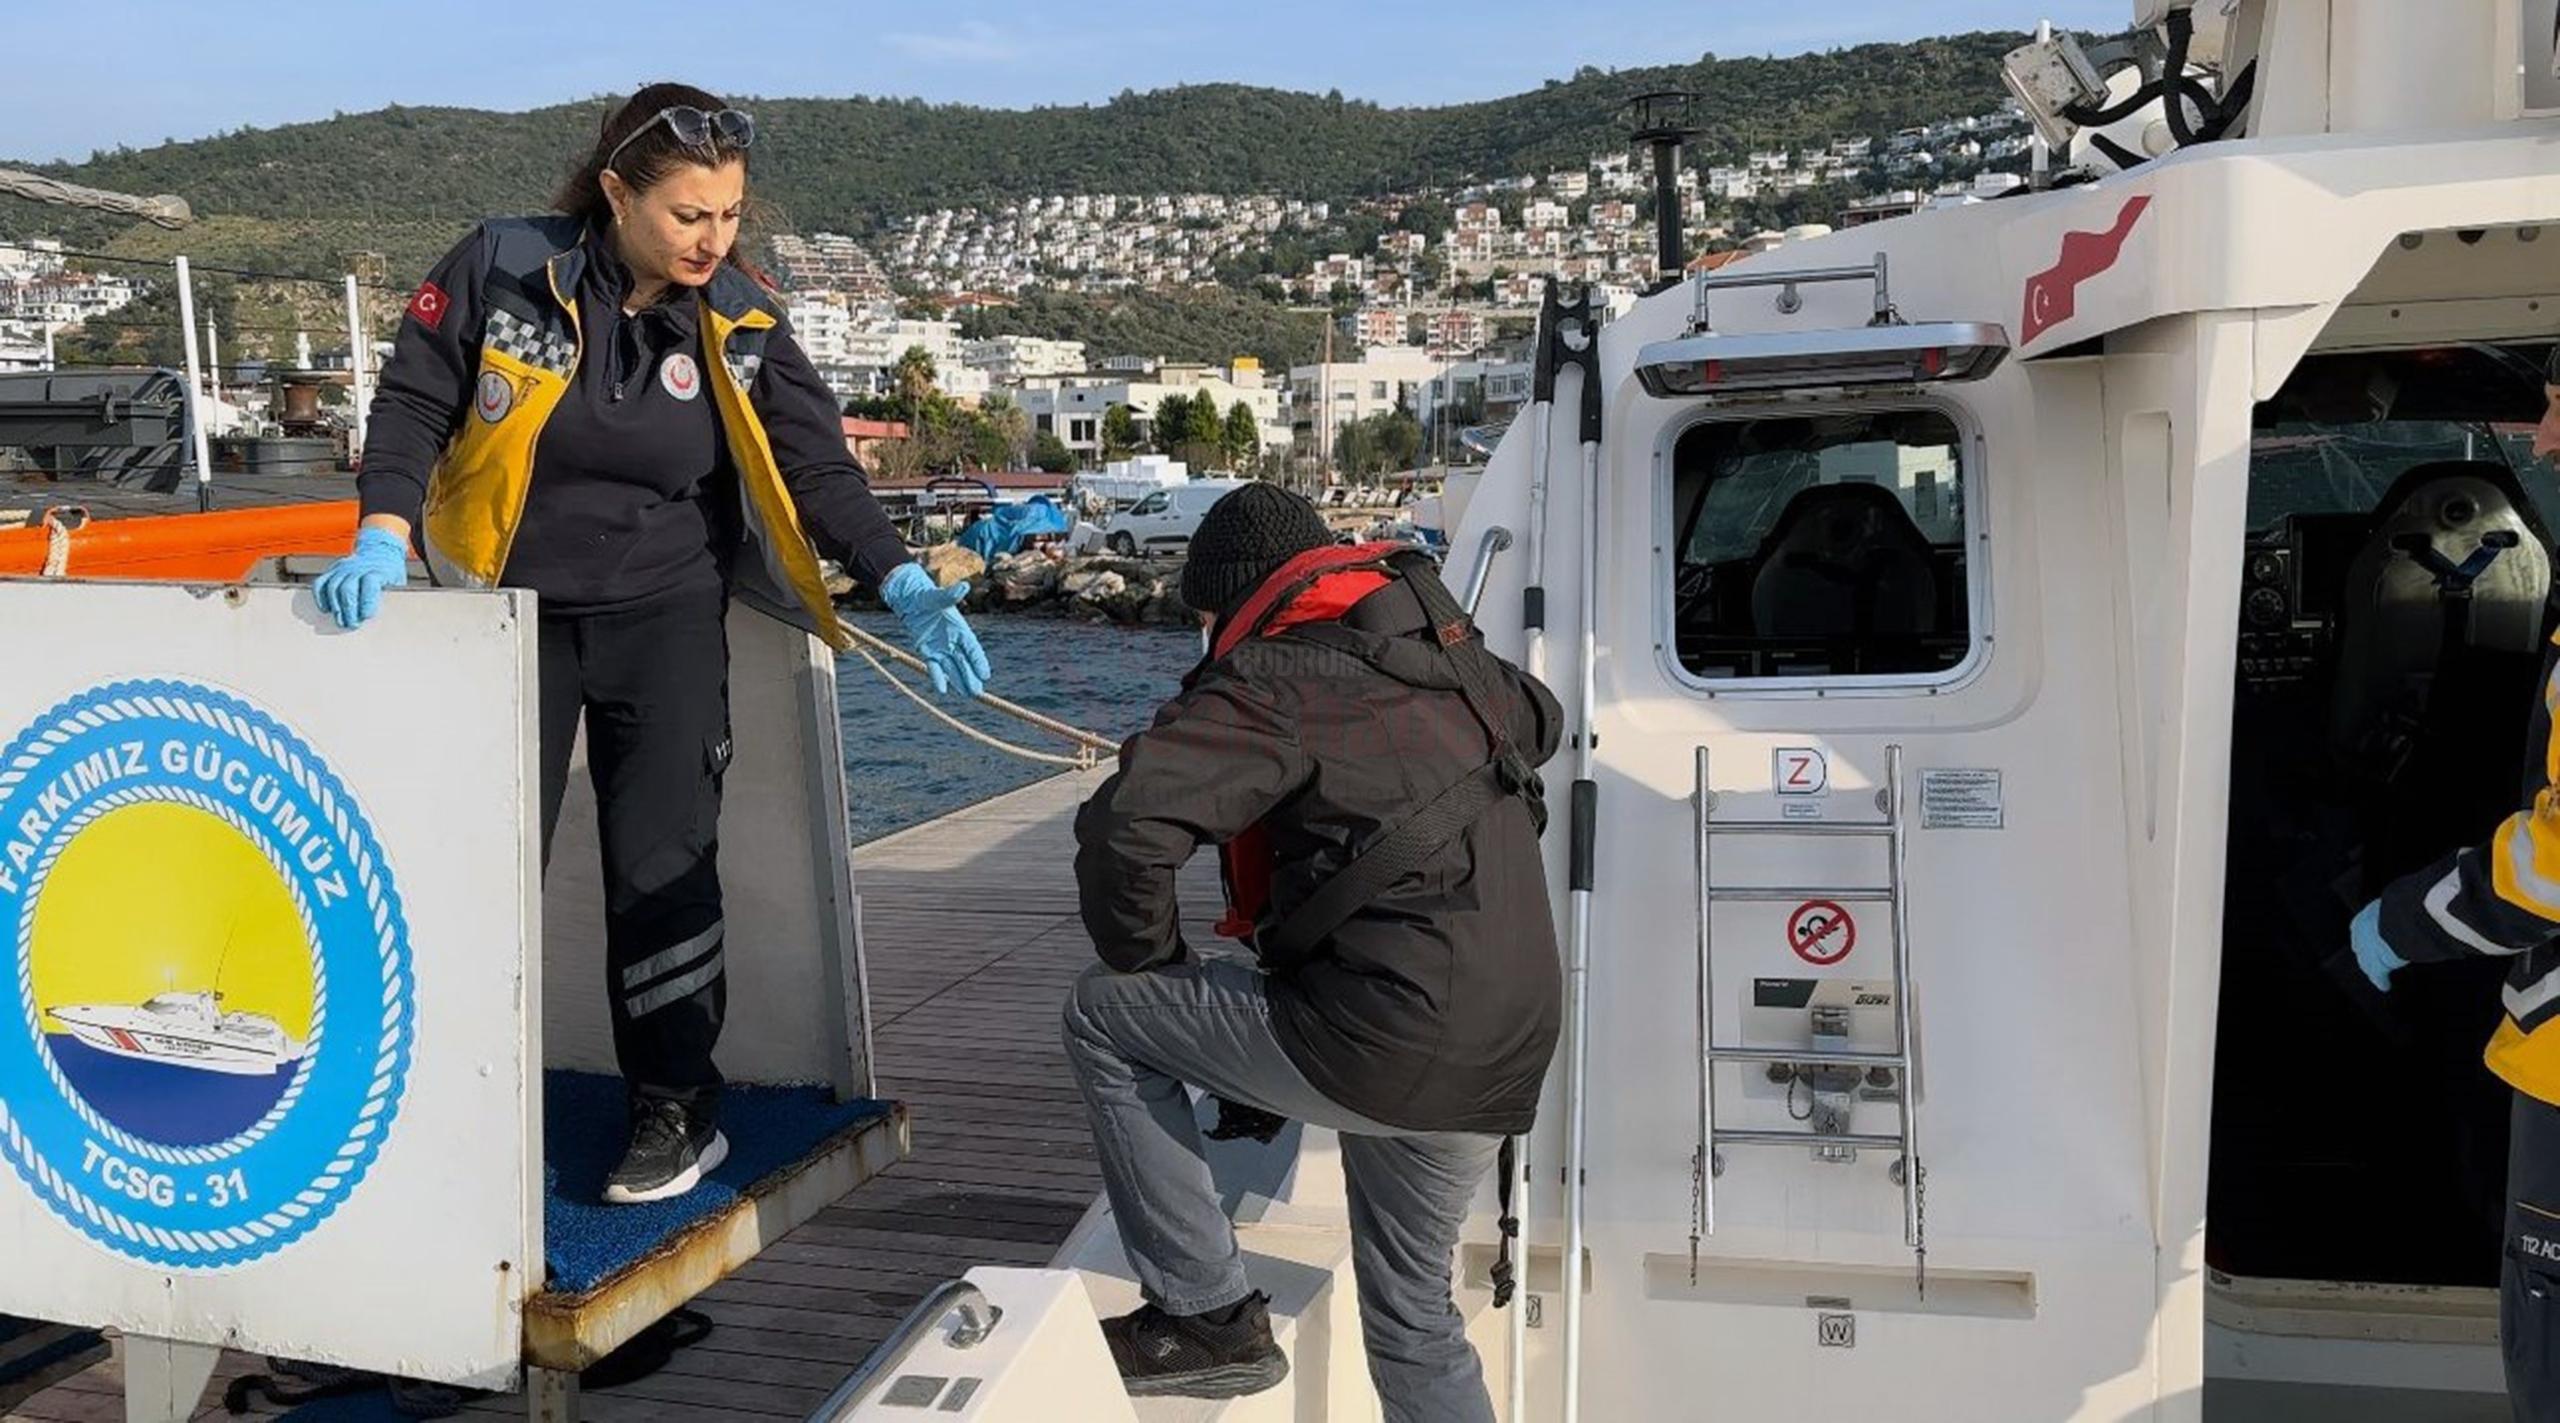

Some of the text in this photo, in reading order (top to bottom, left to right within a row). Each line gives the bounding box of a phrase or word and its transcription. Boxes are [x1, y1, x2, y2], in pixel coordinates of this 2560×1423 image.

[1787, 757, 1811, 785] Z
[0, 739, 349, 908] FARKIMIZ GÜCÜMÜZ
[82, 1138, 175, 1207] TCSG
[205, 1168, 248, 1207] 31
[2520, 1234, 2540, 1255] 112
[1825, 1322, 1848, 1340] W
